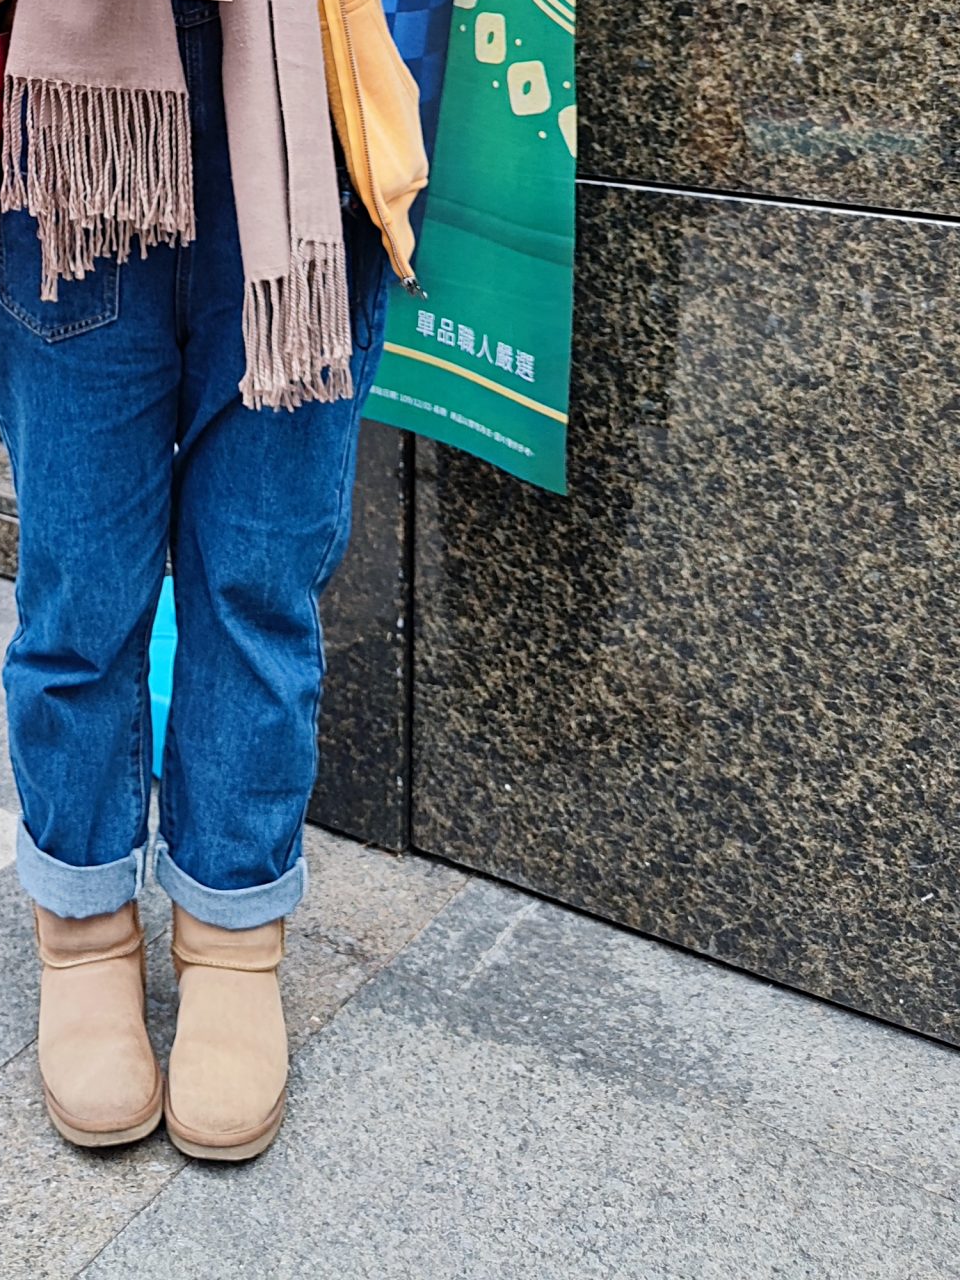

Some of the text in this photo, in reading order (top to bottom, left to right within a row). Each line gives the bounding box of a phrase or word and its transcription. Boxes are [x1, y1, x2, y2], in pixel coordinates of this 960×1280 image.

[416, 310, 535, 383] 單品職人嚴選
